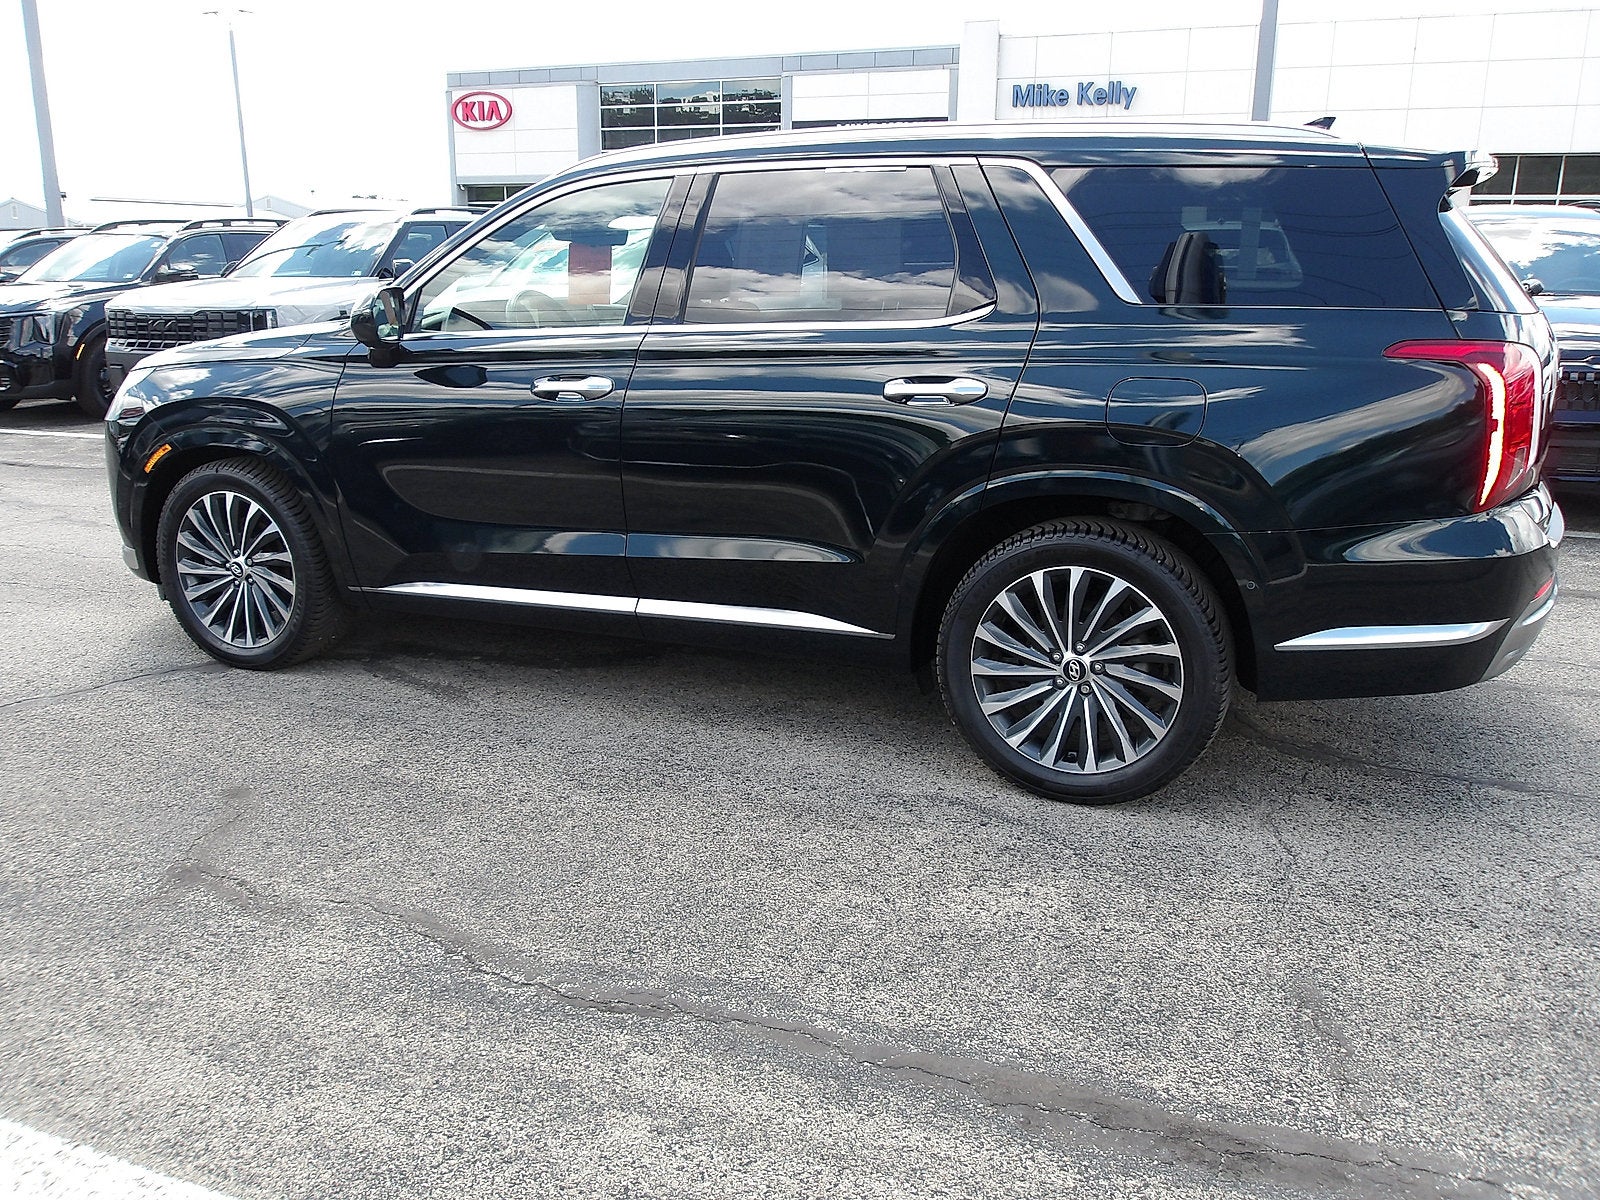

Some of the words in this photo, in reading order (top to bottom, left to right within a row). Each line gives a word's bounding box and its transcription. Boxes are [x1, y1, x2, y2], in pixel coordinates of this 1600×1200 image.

[1012, 84, 1070, 108] Mike
[1076, 80, 1138, 110] Kelly
[461, 100, 502, 122] KIA
